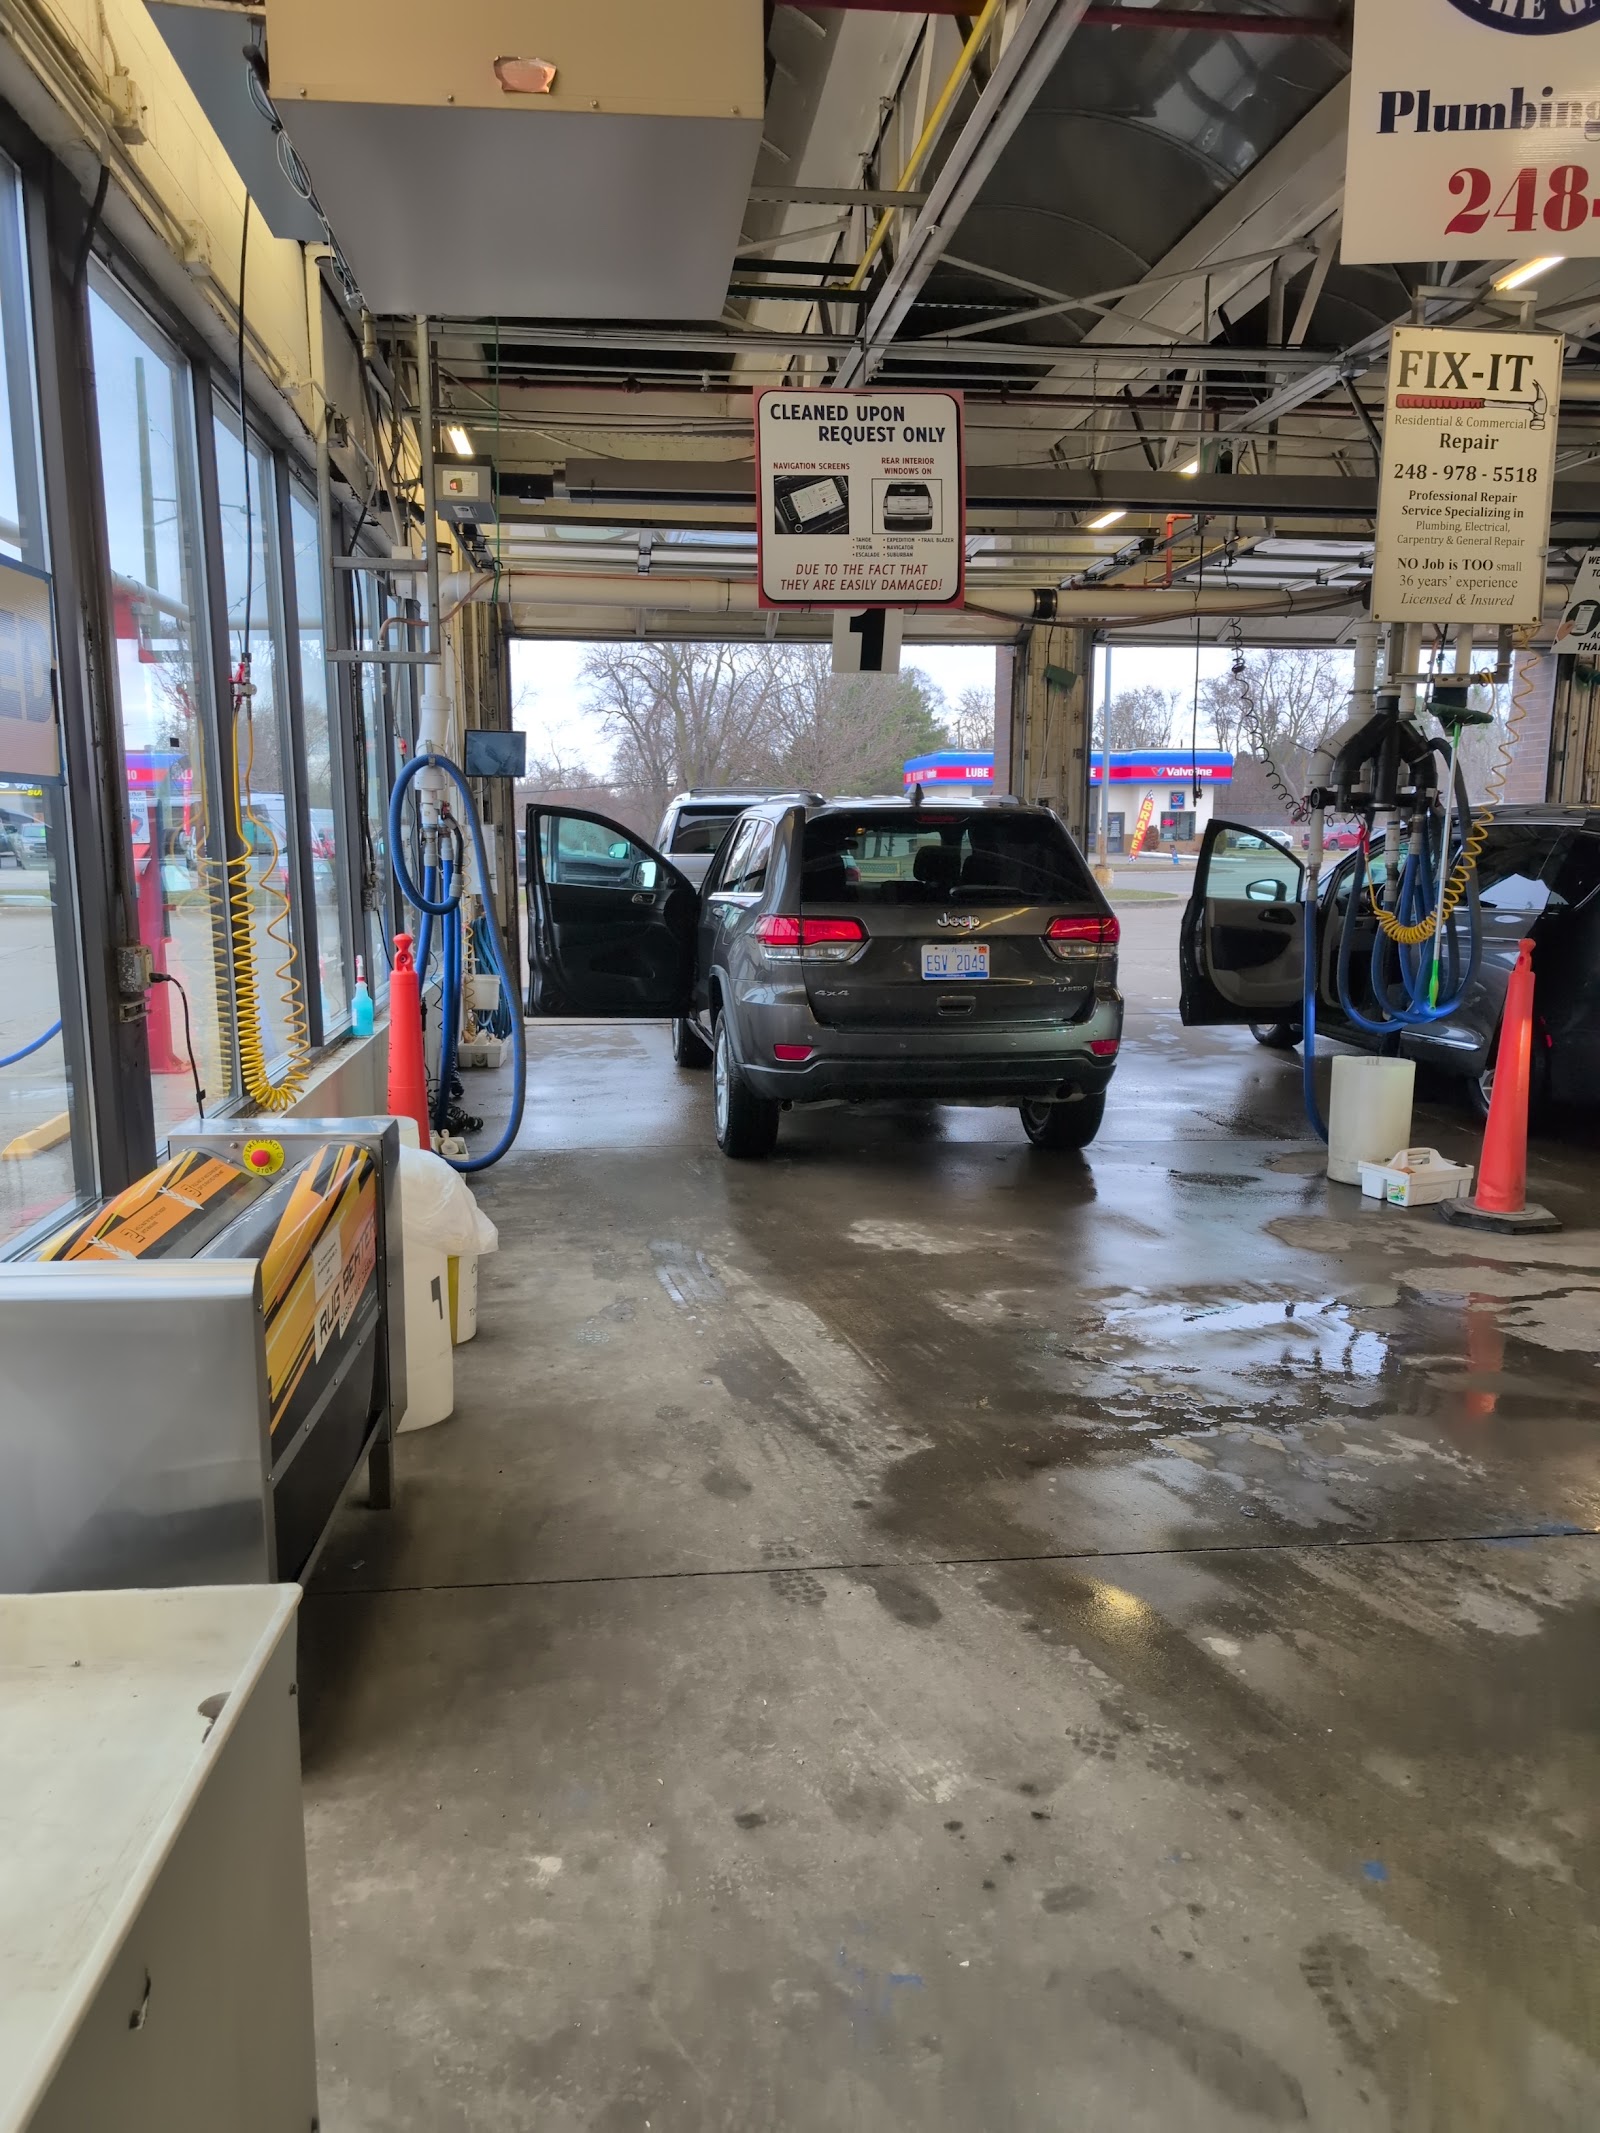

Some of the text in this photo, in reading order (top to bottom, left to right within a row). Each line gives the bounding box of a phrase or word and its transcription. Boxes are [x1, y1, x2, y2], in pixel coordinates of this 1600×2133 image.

[1376, 86, 1600, 141] Plumbing
[1396, 350, 1534, 392] FIX-IT
[770, 403, 905, 422] CLEANED UPON
[1394, 414, 1527, 429] Residential & Commercial
[819, 425, 946, 445] REQUEST ONLY
[1439, 433, 1499, 453] Repair
[773, 462, 816, 470] NAVIGATION
[881, 457, 934, 465] REAR INTERIOR
[884, 467, 919, 475] WINDOWS
[1393, 463, 1428, 480] 248
[1443, 465, 1477, 481] 978
[1492, 466, 1537, 483] 5518
[1408, 490, 1518, 504] Professional Repair
[1401, 505, 1524, 520] Service Specializing in
[1416, 520, 1511, 533] Plumbing, Electrical,
[1397, 535, 1525, 548] Carpentry & General Repair
[796, 563, 928, 575] DUE TO THE FACT THAT
[1397, 557, 1522, 572] NO Job is TOO small
[780, 579, 943, 591] THEY ARE EASILY DAMAGED!
[1400, 575, 1414, 587] 36
[1455, 577, 1518, 589] experience
[1401, 592, 1515, 606] Licensed & Insured
[849, 609, 886, 671] 1
[1577, 643, 1600, 651] THA
[965, 767, 989, 778] LUBE
[1166, 767, 1212, 777] Valvoine
[1131, 800, 1153, 849] BRAKE
[937, 912, 980, 930] Jeep
[926, 954, 985, 971] ESV 2049
[814, 989, 850, 997] 4x4
[256, 1166, 273, 1174] STOP
[319, 1283, 341, 1345] RUG
